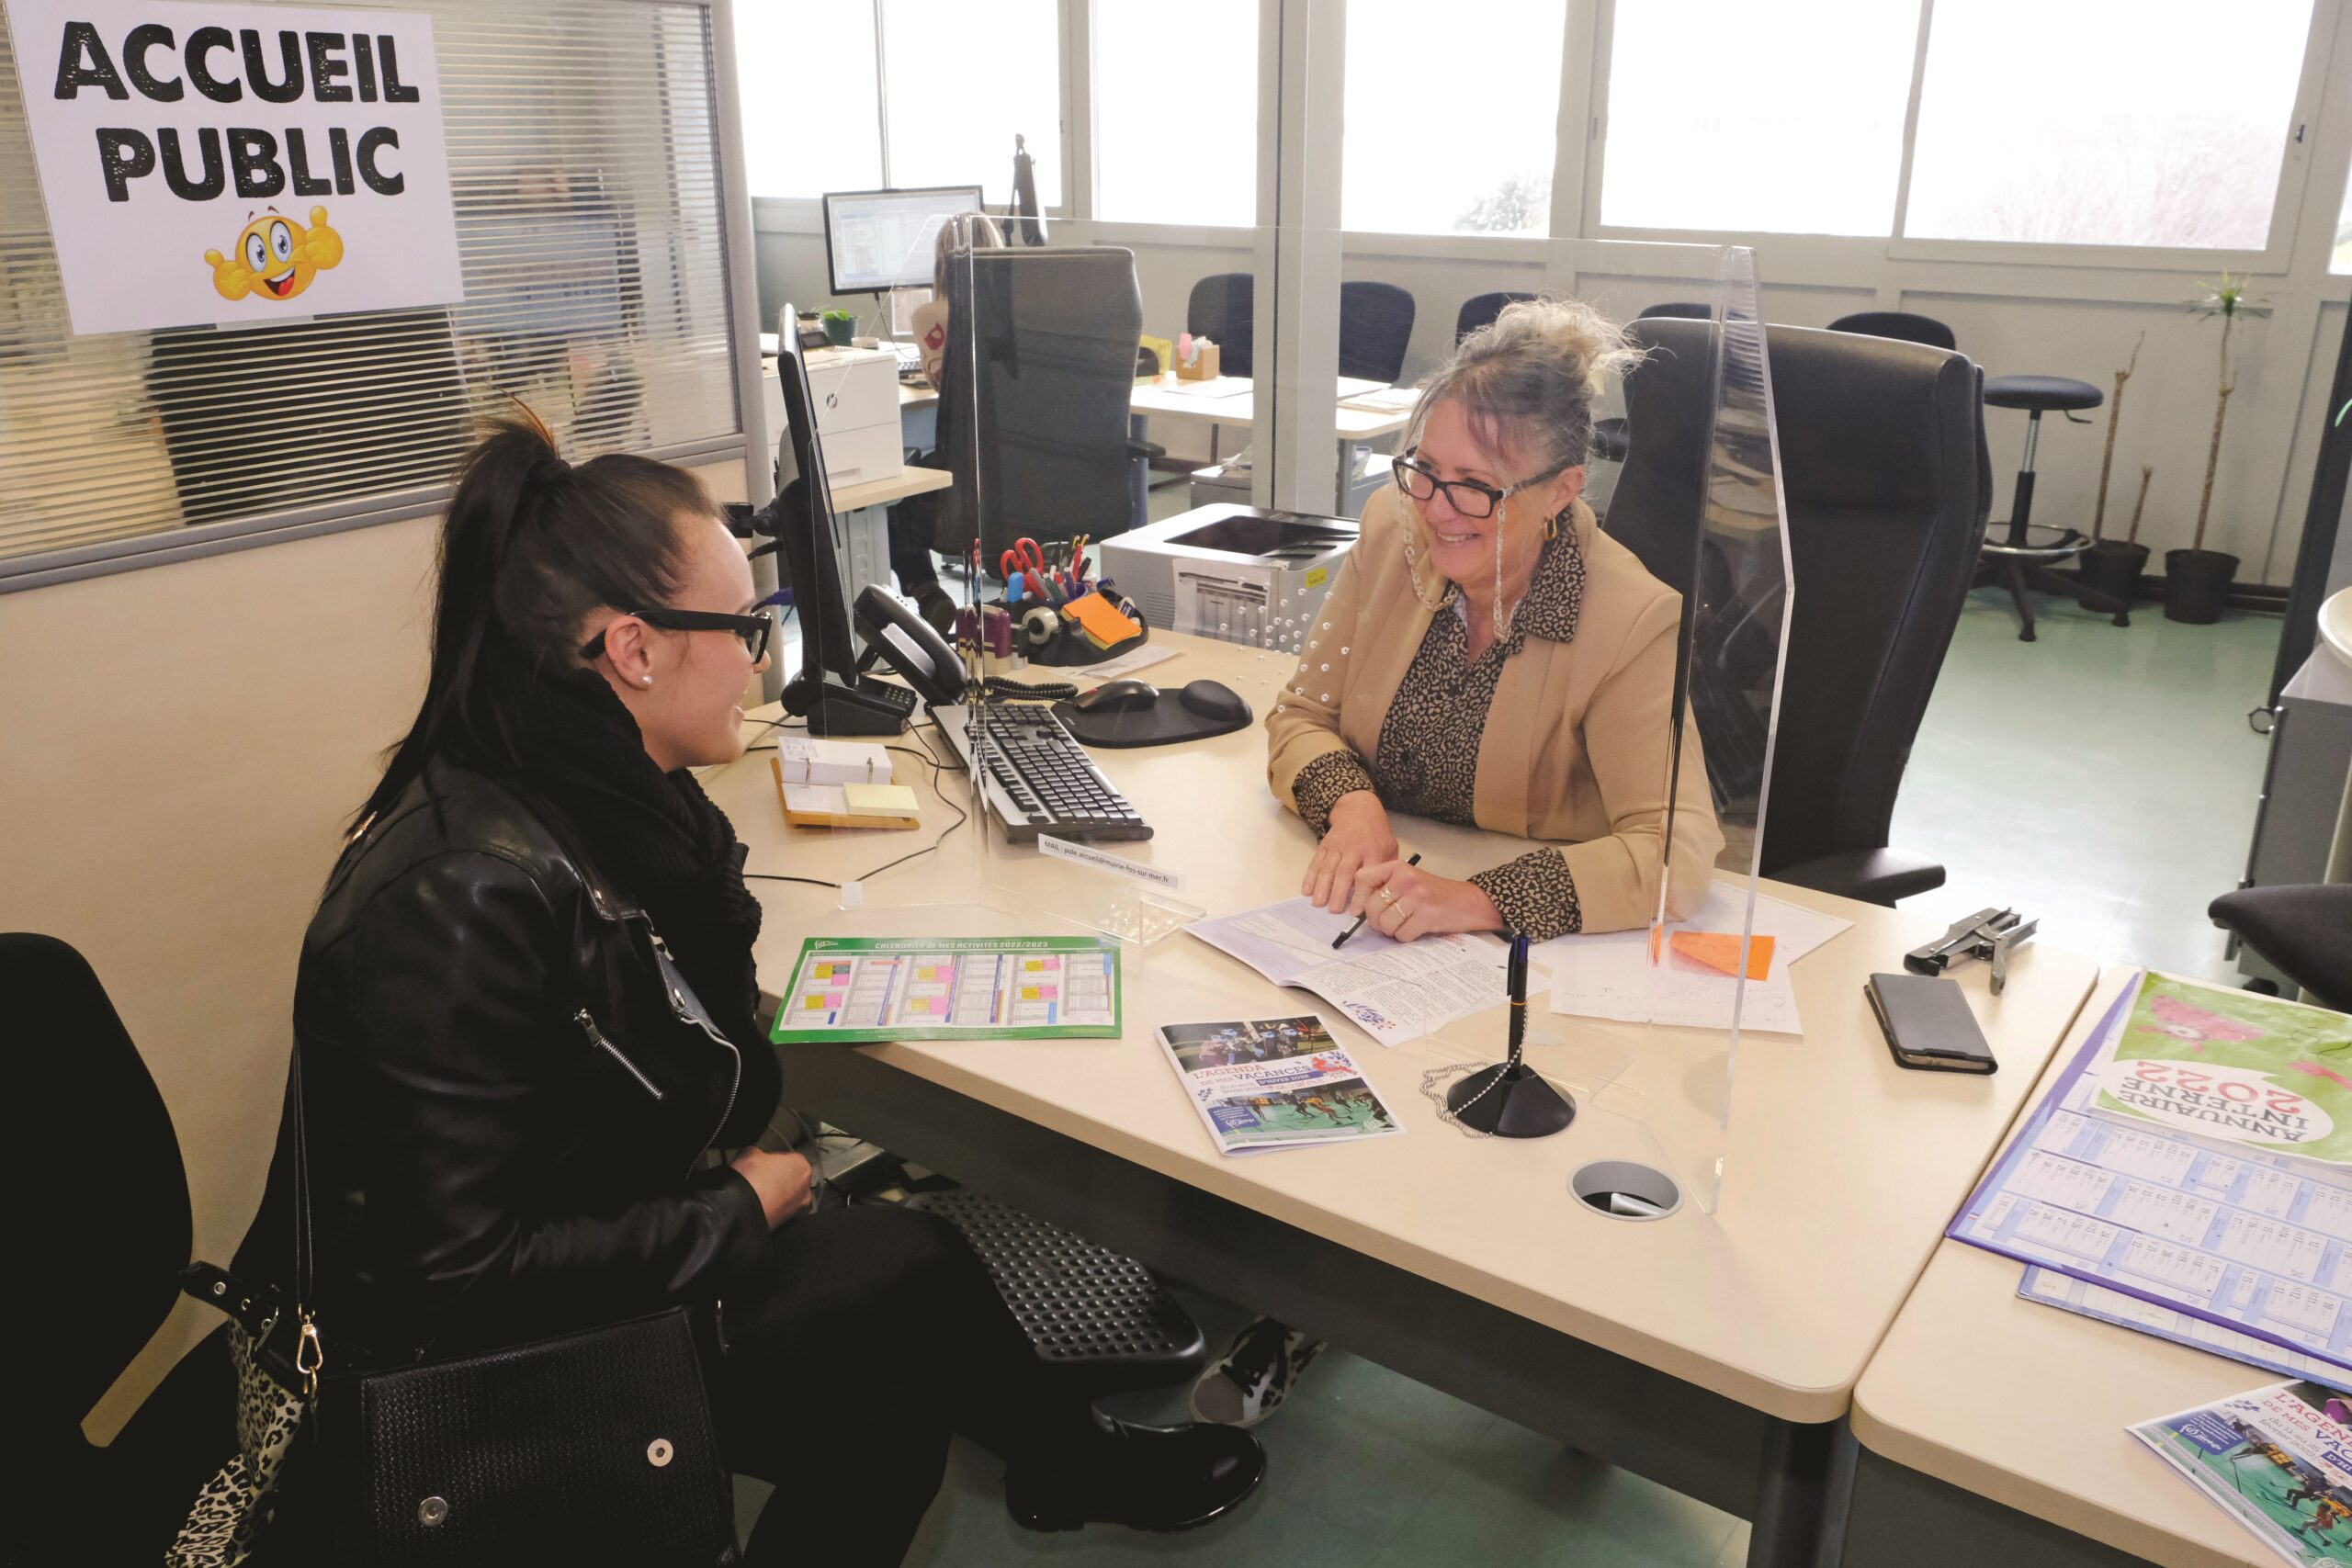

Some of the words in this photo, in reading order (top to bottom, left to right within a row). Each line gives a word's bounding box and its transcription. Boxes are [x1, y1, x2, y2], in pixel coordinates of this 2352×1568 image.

[53, 21, 420, 103] ACCUEIL
[96, 126, 405, 202] PUBLIC
[1044, 840, 1059, 852] MAIL
[1064, 847, 1170, 884] pole.accueil@mairie-fos-sur-mer.fr
[1193, 1065, 1265, 1079] L'AGENDA
[1234, 1066, 1311, 1080] VACANCES
[2134, 1060, 2304, 1114] 2022
[2117, 1089, 2308, 1142] ANNUAIRE
[2120, 1076, 2310, 1131] INTERNE
[2259, 1418, 2291, 1440] février
[2262, 1399, 2282, 1413] DE
[2281, 1413, 2310, 1431] MES
[2268, 1417, 2283, 1427] du
[2294, 1434, 2307, 1443] au
[2274, 1393, 2352, 1447] L'AGEN
